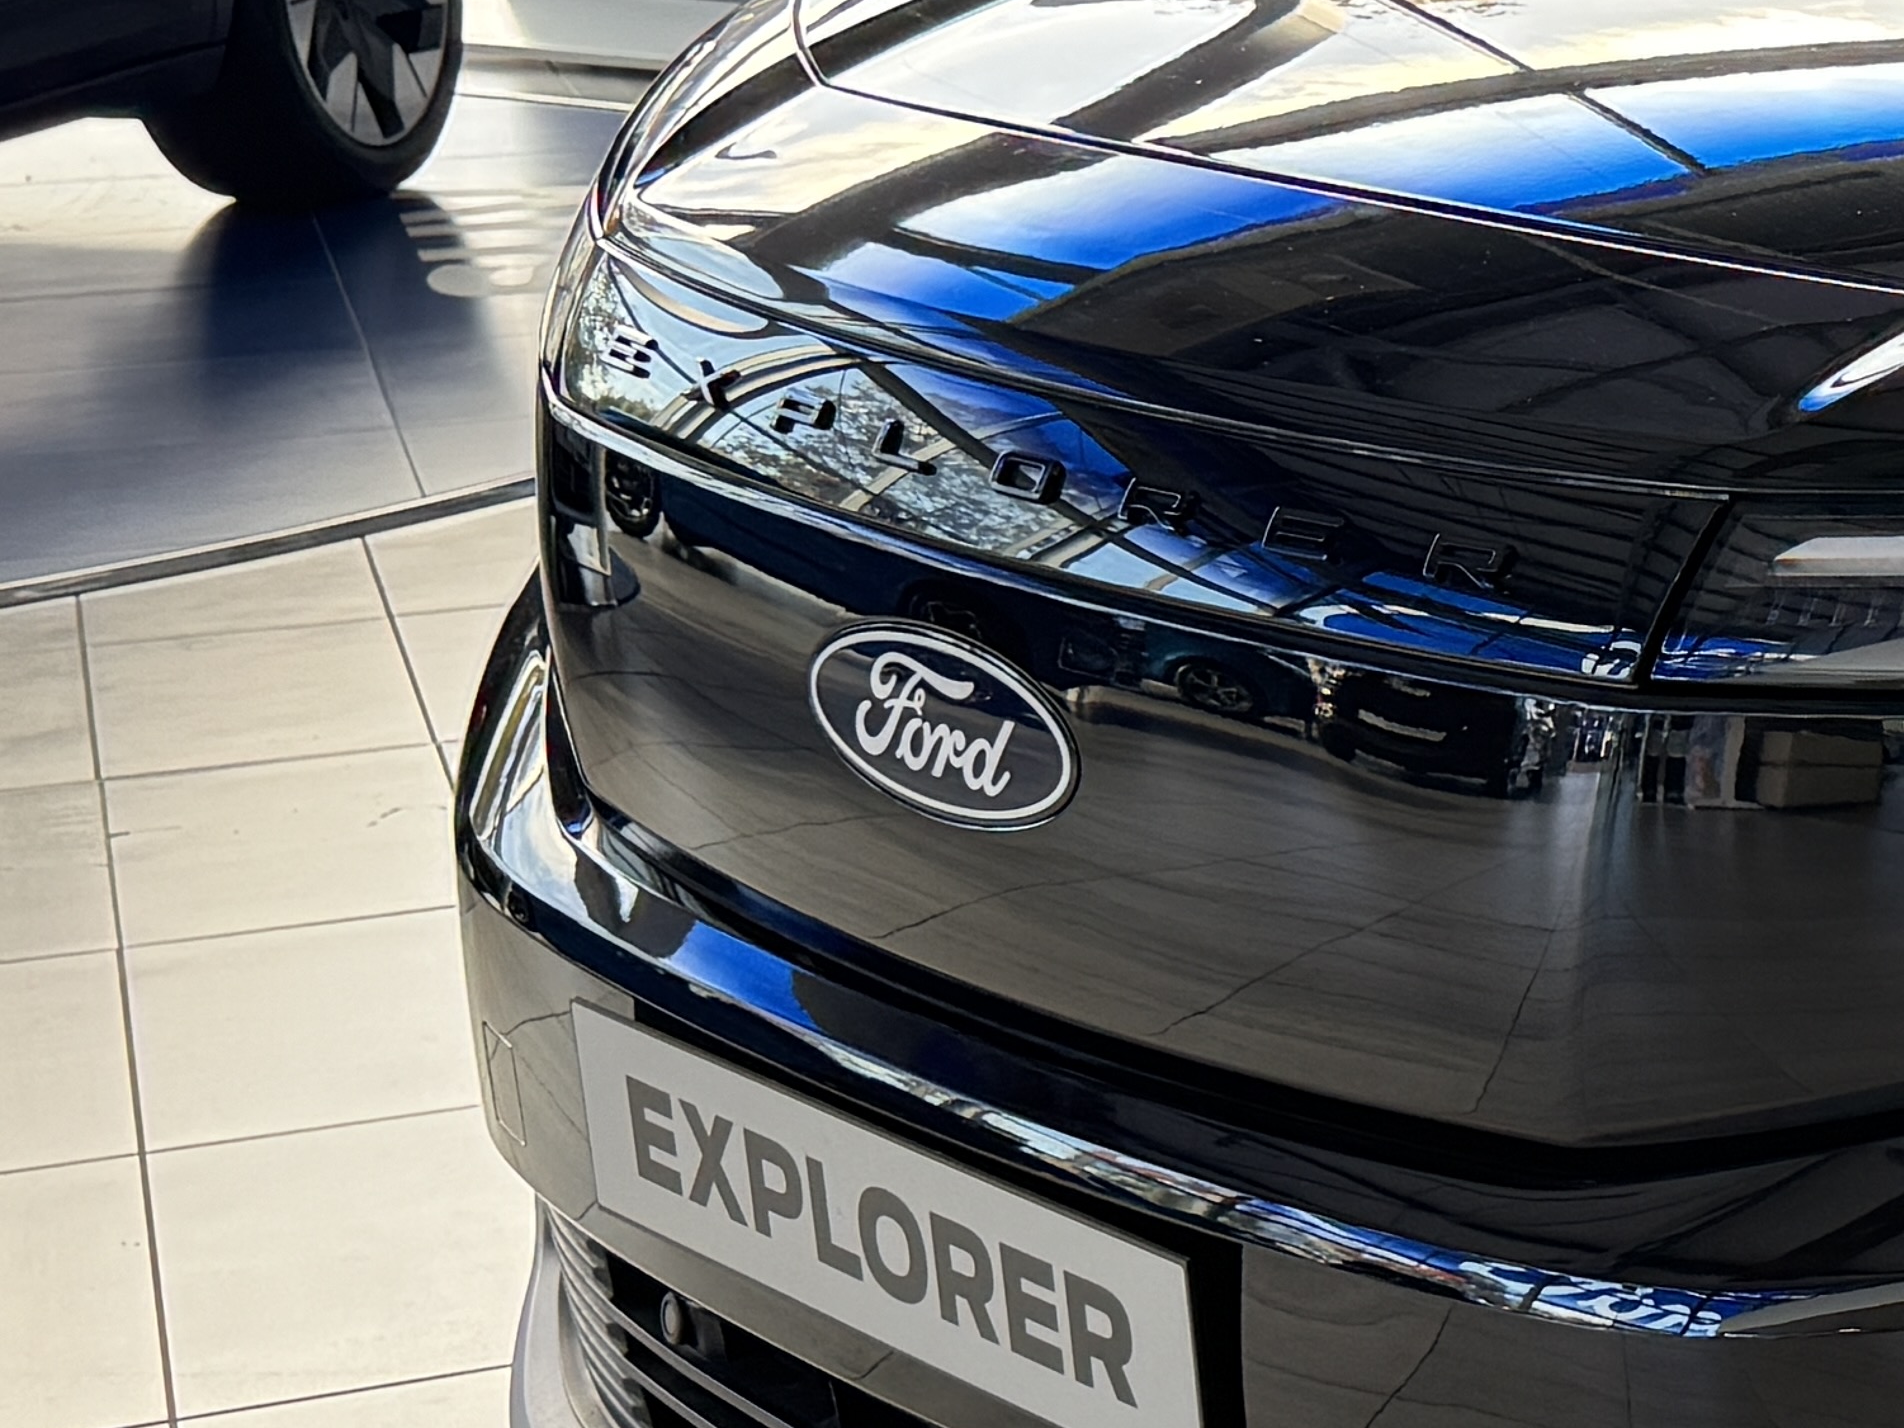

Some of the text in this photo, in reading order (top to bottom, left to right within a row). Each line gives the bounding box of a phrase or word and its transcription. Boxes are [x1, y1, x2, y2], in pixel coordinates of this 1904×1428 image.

[604, 322, 1518, 594] EXPLORER
[853, 650, 1018, 800] Ford
[624, 1073, 1140, 1410] EXPLORER
